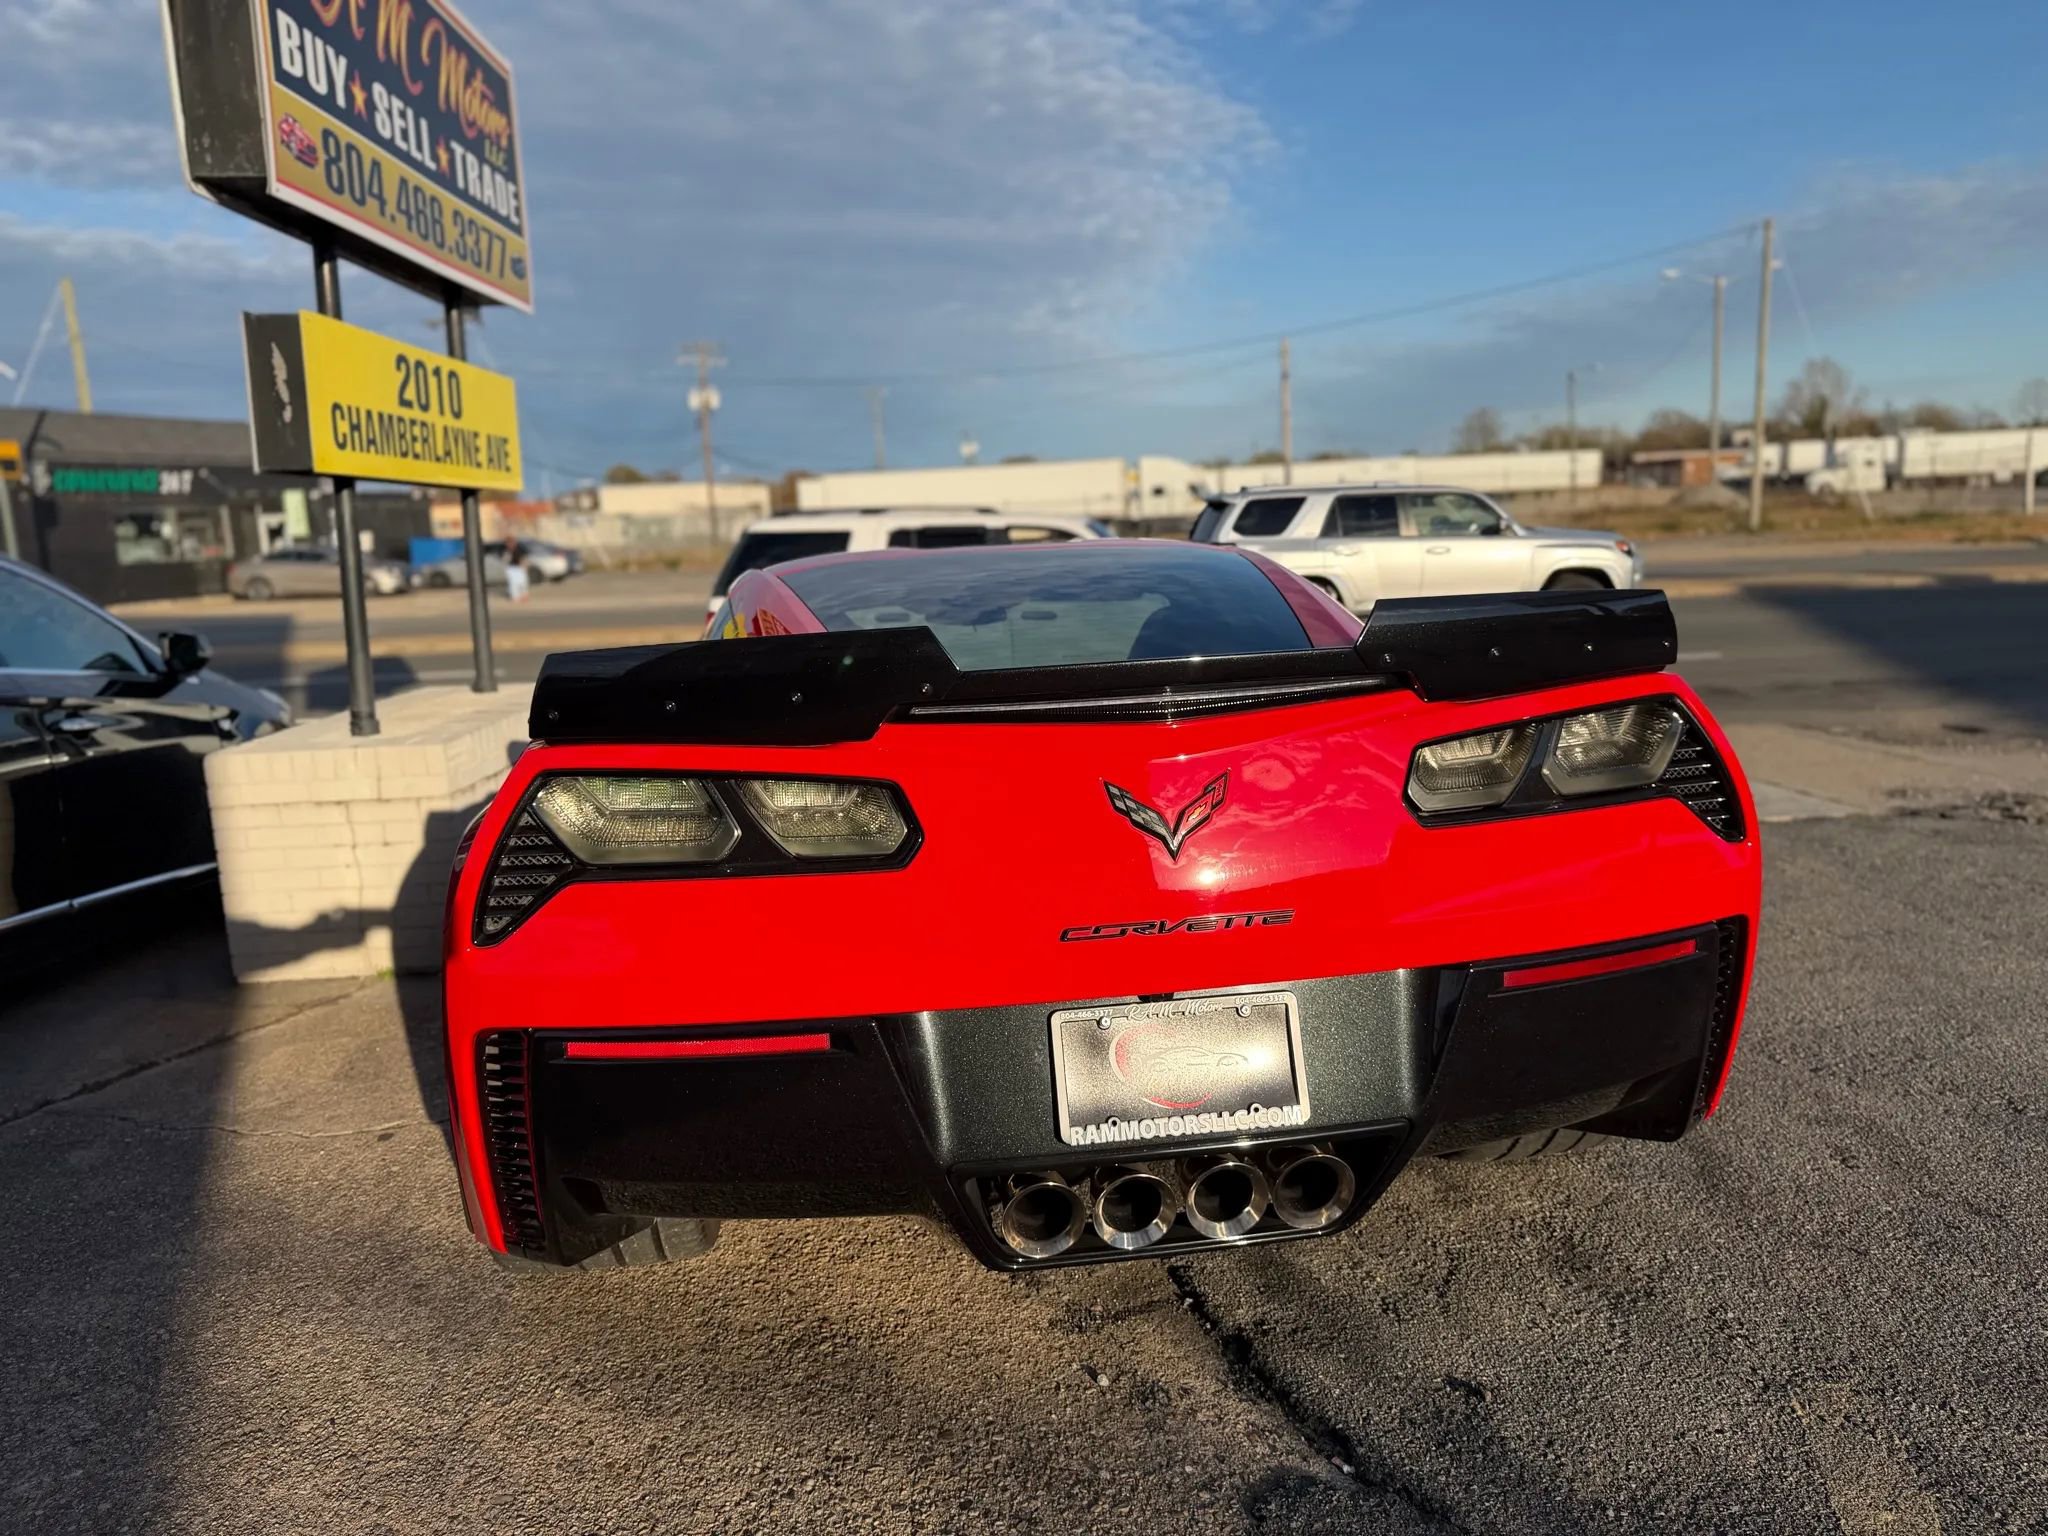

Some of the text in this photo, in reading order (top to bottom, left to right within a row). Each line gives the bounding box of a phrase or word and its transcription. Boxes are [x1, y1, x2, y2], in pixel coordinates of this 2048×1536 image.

[275, 8, 348, 109] BUY
[371, 81, 437, 171] SELL
[449, 138, 520, 226] TRADE
[395, 352, 463, 420] 2010
[331, 401, 512, 473] CHAMBERLAYNE AVE
[1060, 909, 1295, 942] CORVETTE
[1069, 1104, 1306, 1147] RAMMOTORSLLC.COM
